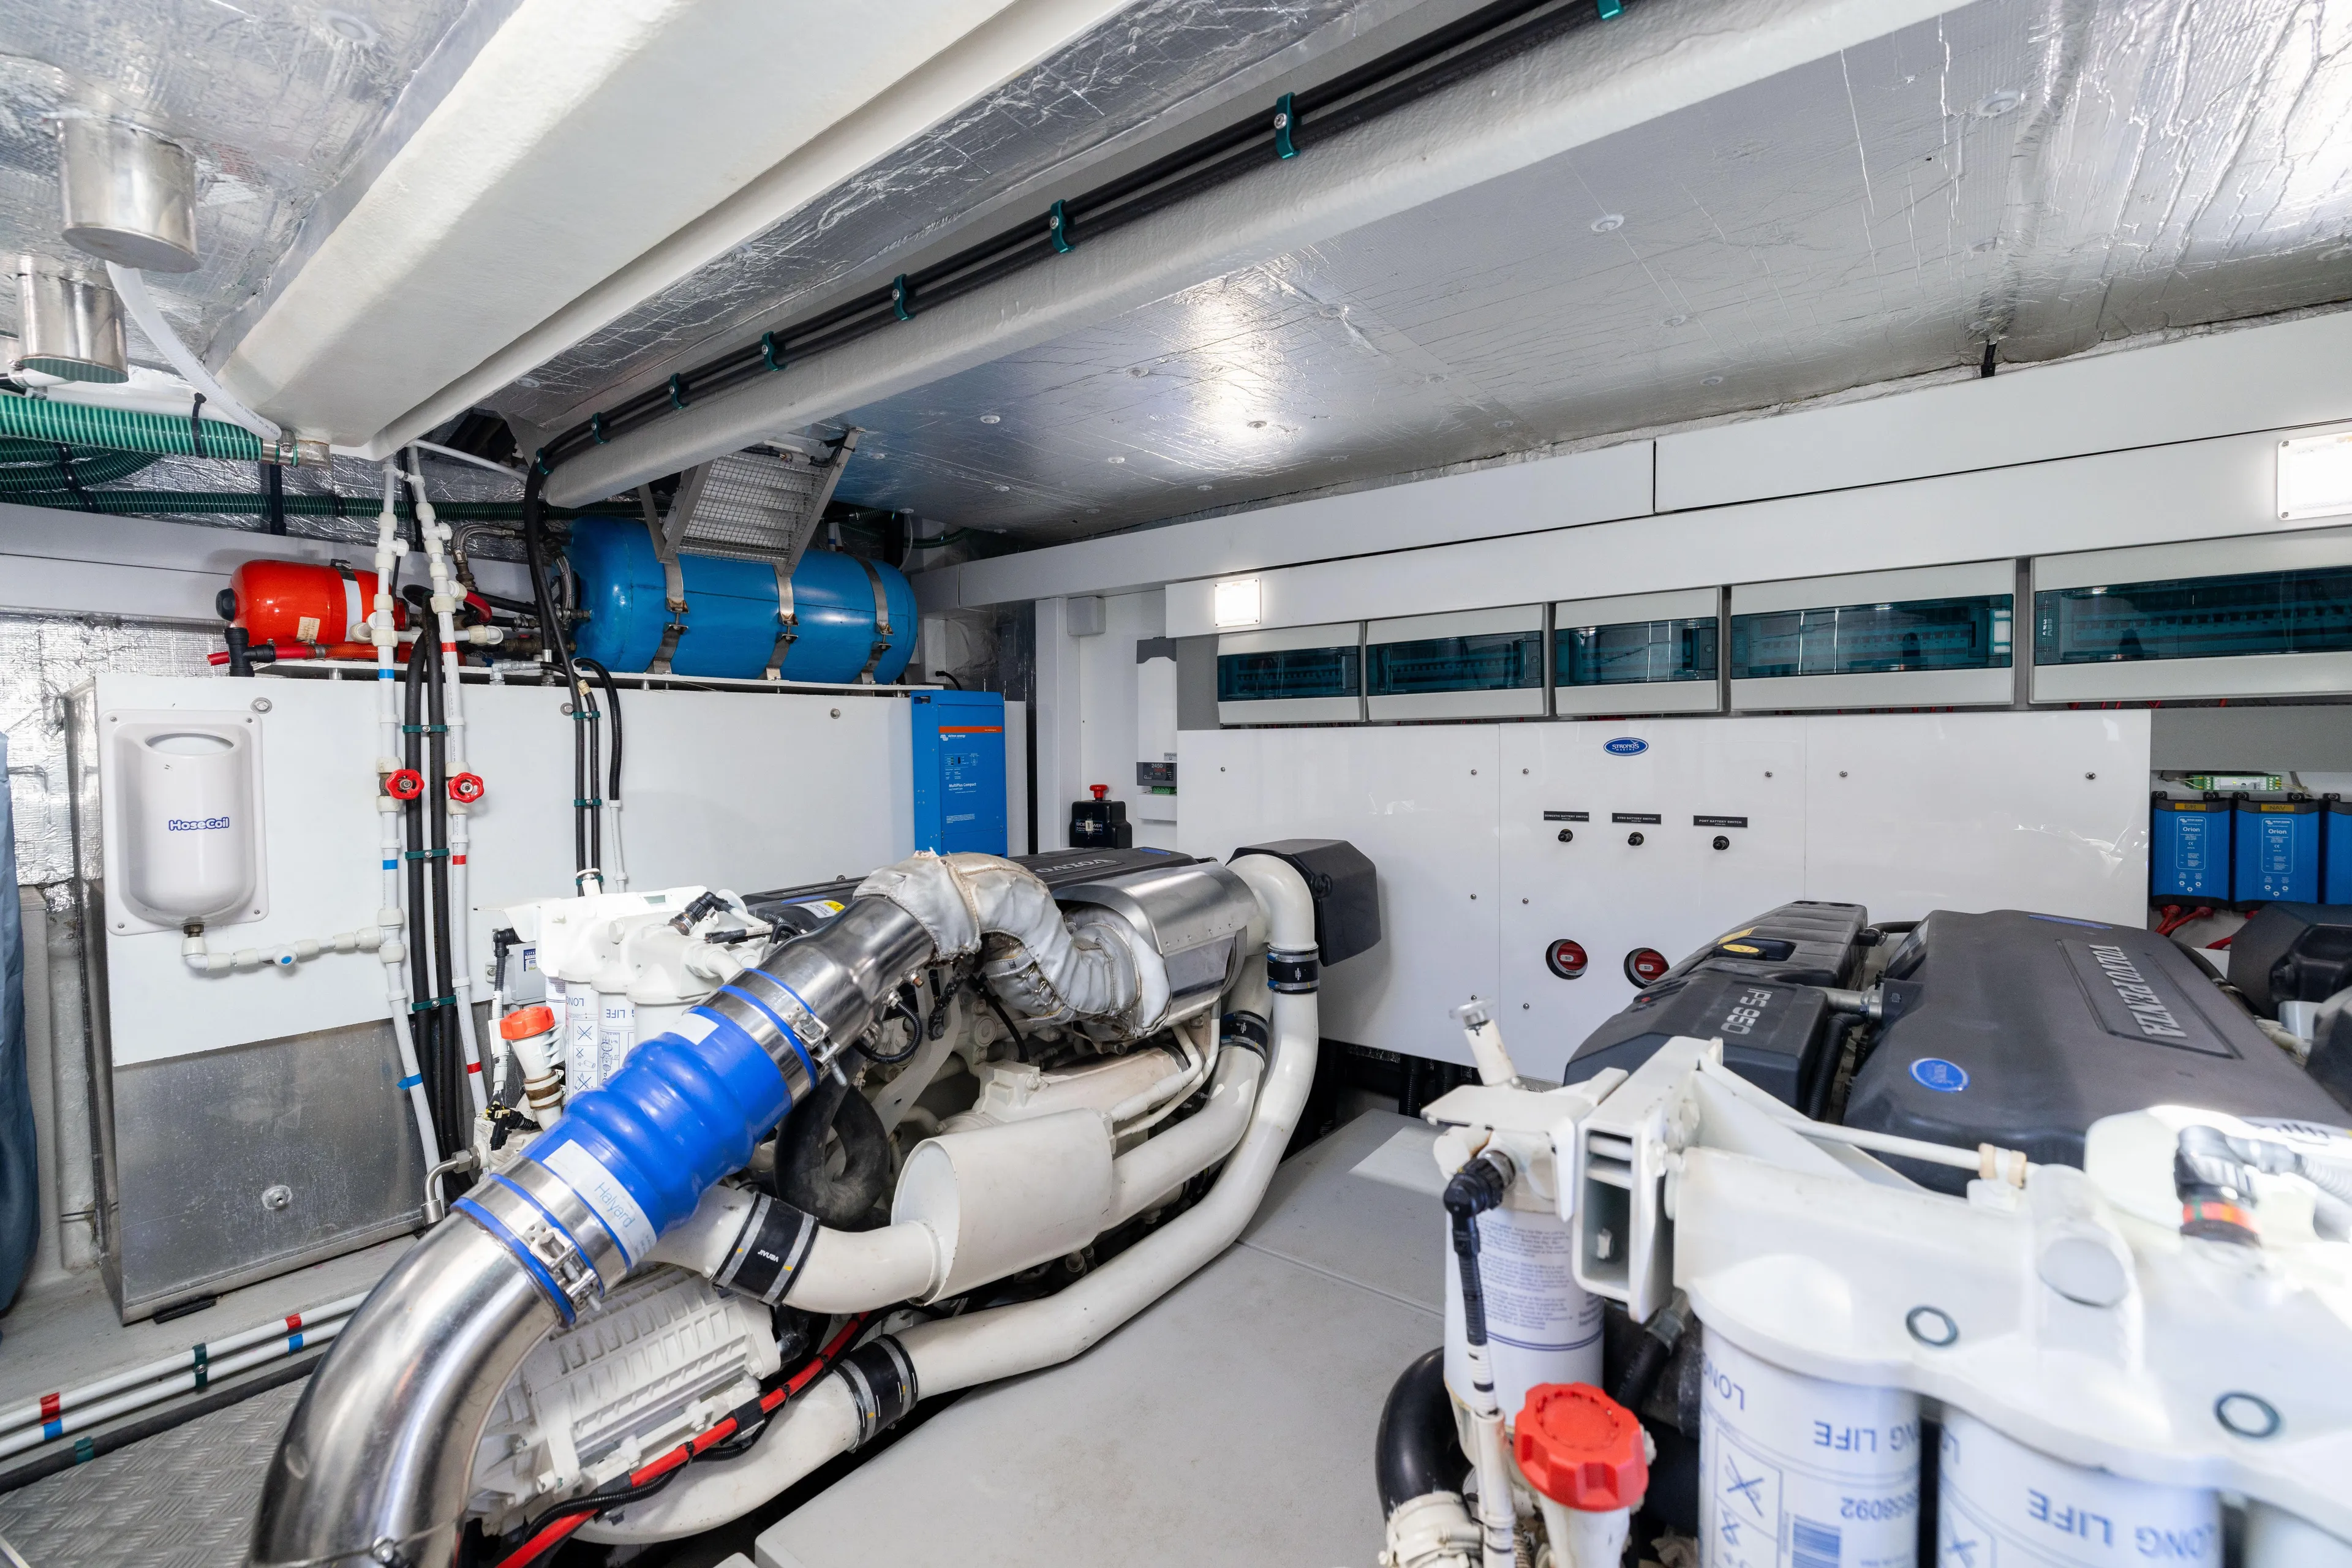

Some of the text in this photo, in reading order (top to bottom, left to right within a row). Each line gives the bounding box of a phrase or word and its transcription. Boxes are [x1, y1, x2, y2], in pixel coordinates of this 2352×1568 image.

[168, 816, 230, 831] HoseCoil
[1035, 859, 1117, 873] VOLVO
[2089, 944, 2187, 1038] VOLVO PENTA
[606, 1009, 625, 1018] LIFE
[1721, 988, 1773, 1035] IPS 950
[594, 1182, 636, 1228] Halyard
[1814, 1420, 1877, 1453] LIFE
[2027, 1487, 2113, 1548] LIFE
